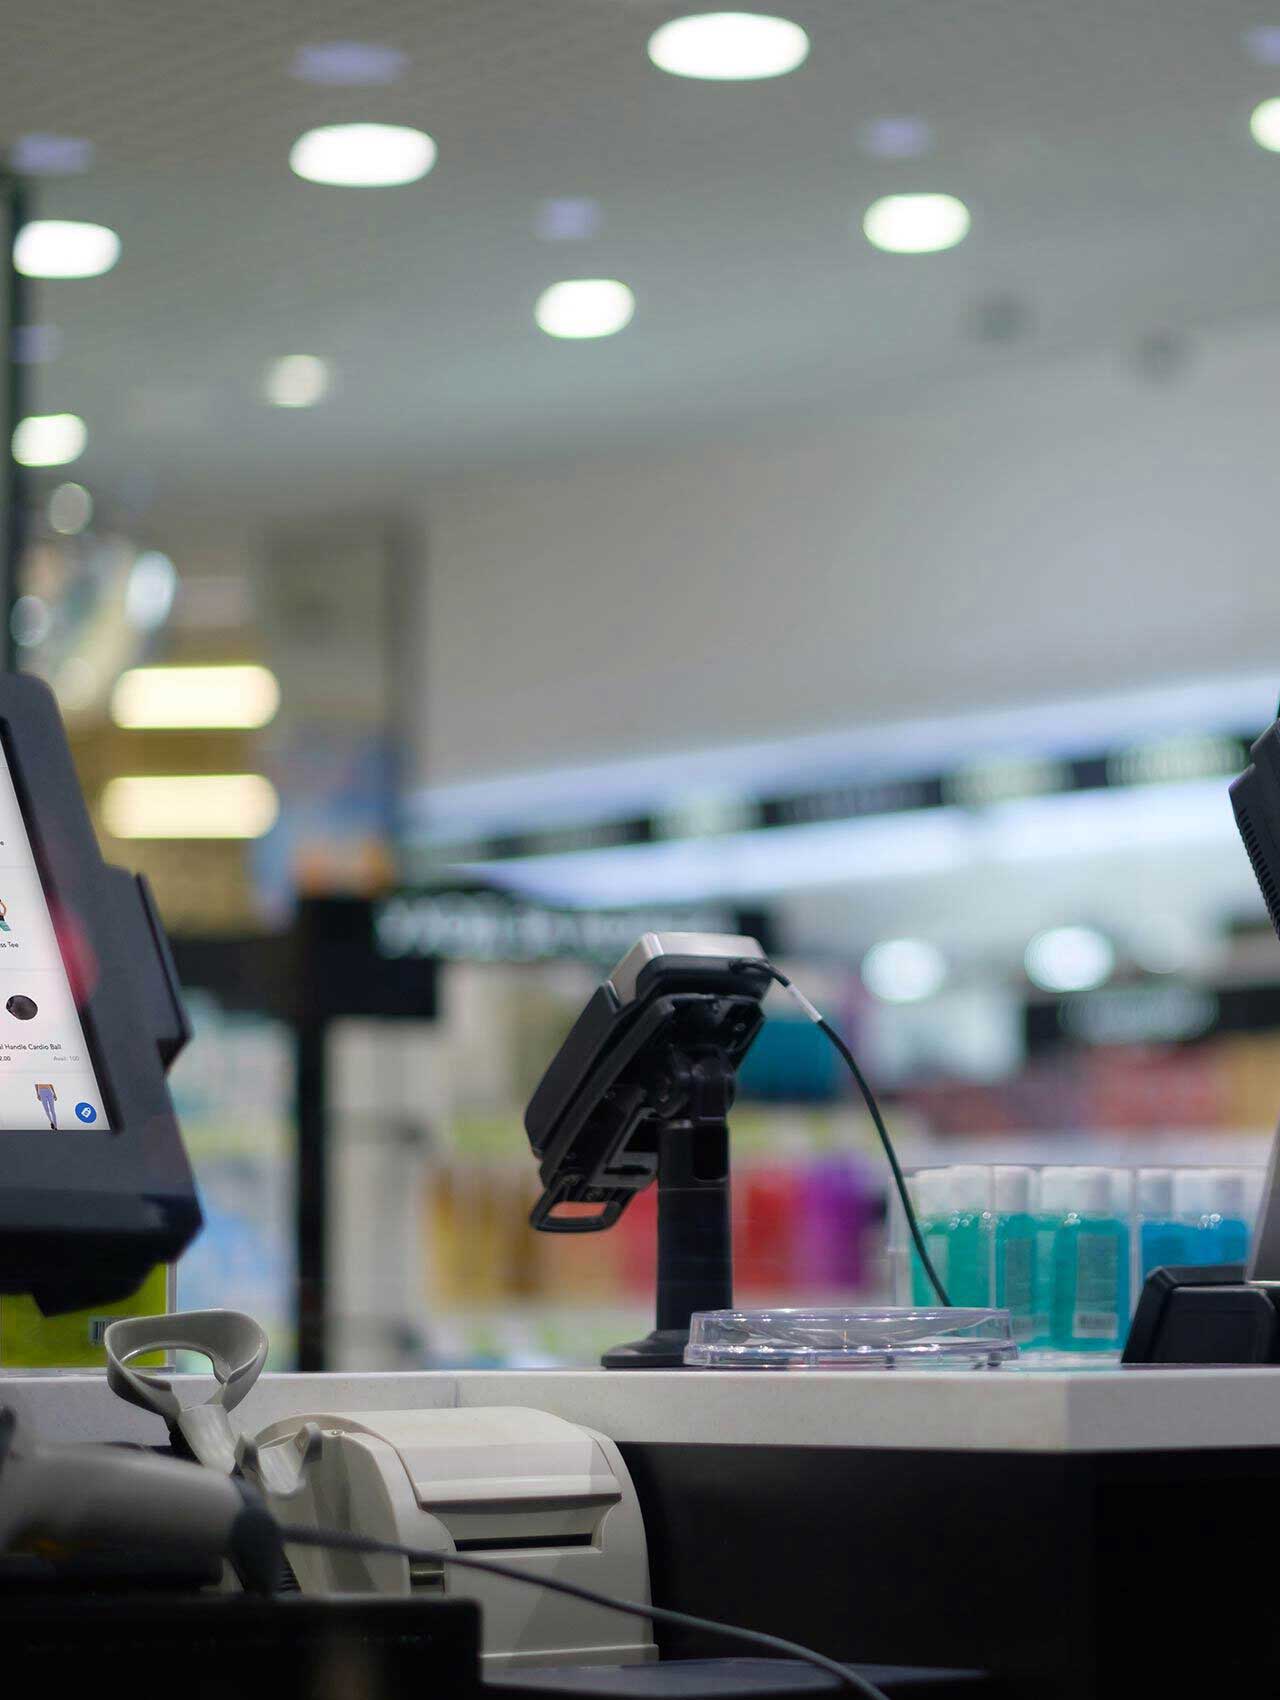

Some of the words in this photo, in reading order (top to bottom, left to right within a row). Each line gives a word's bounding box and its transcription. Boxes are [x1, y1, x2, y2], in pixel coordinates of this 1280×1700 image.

[8, 941, 19, 949] Tee
[5, 1043, 27, 1051] Handle
[28, 1043, 49, 1051] Cardio
[50, 1043, 62, 1051] Ball
